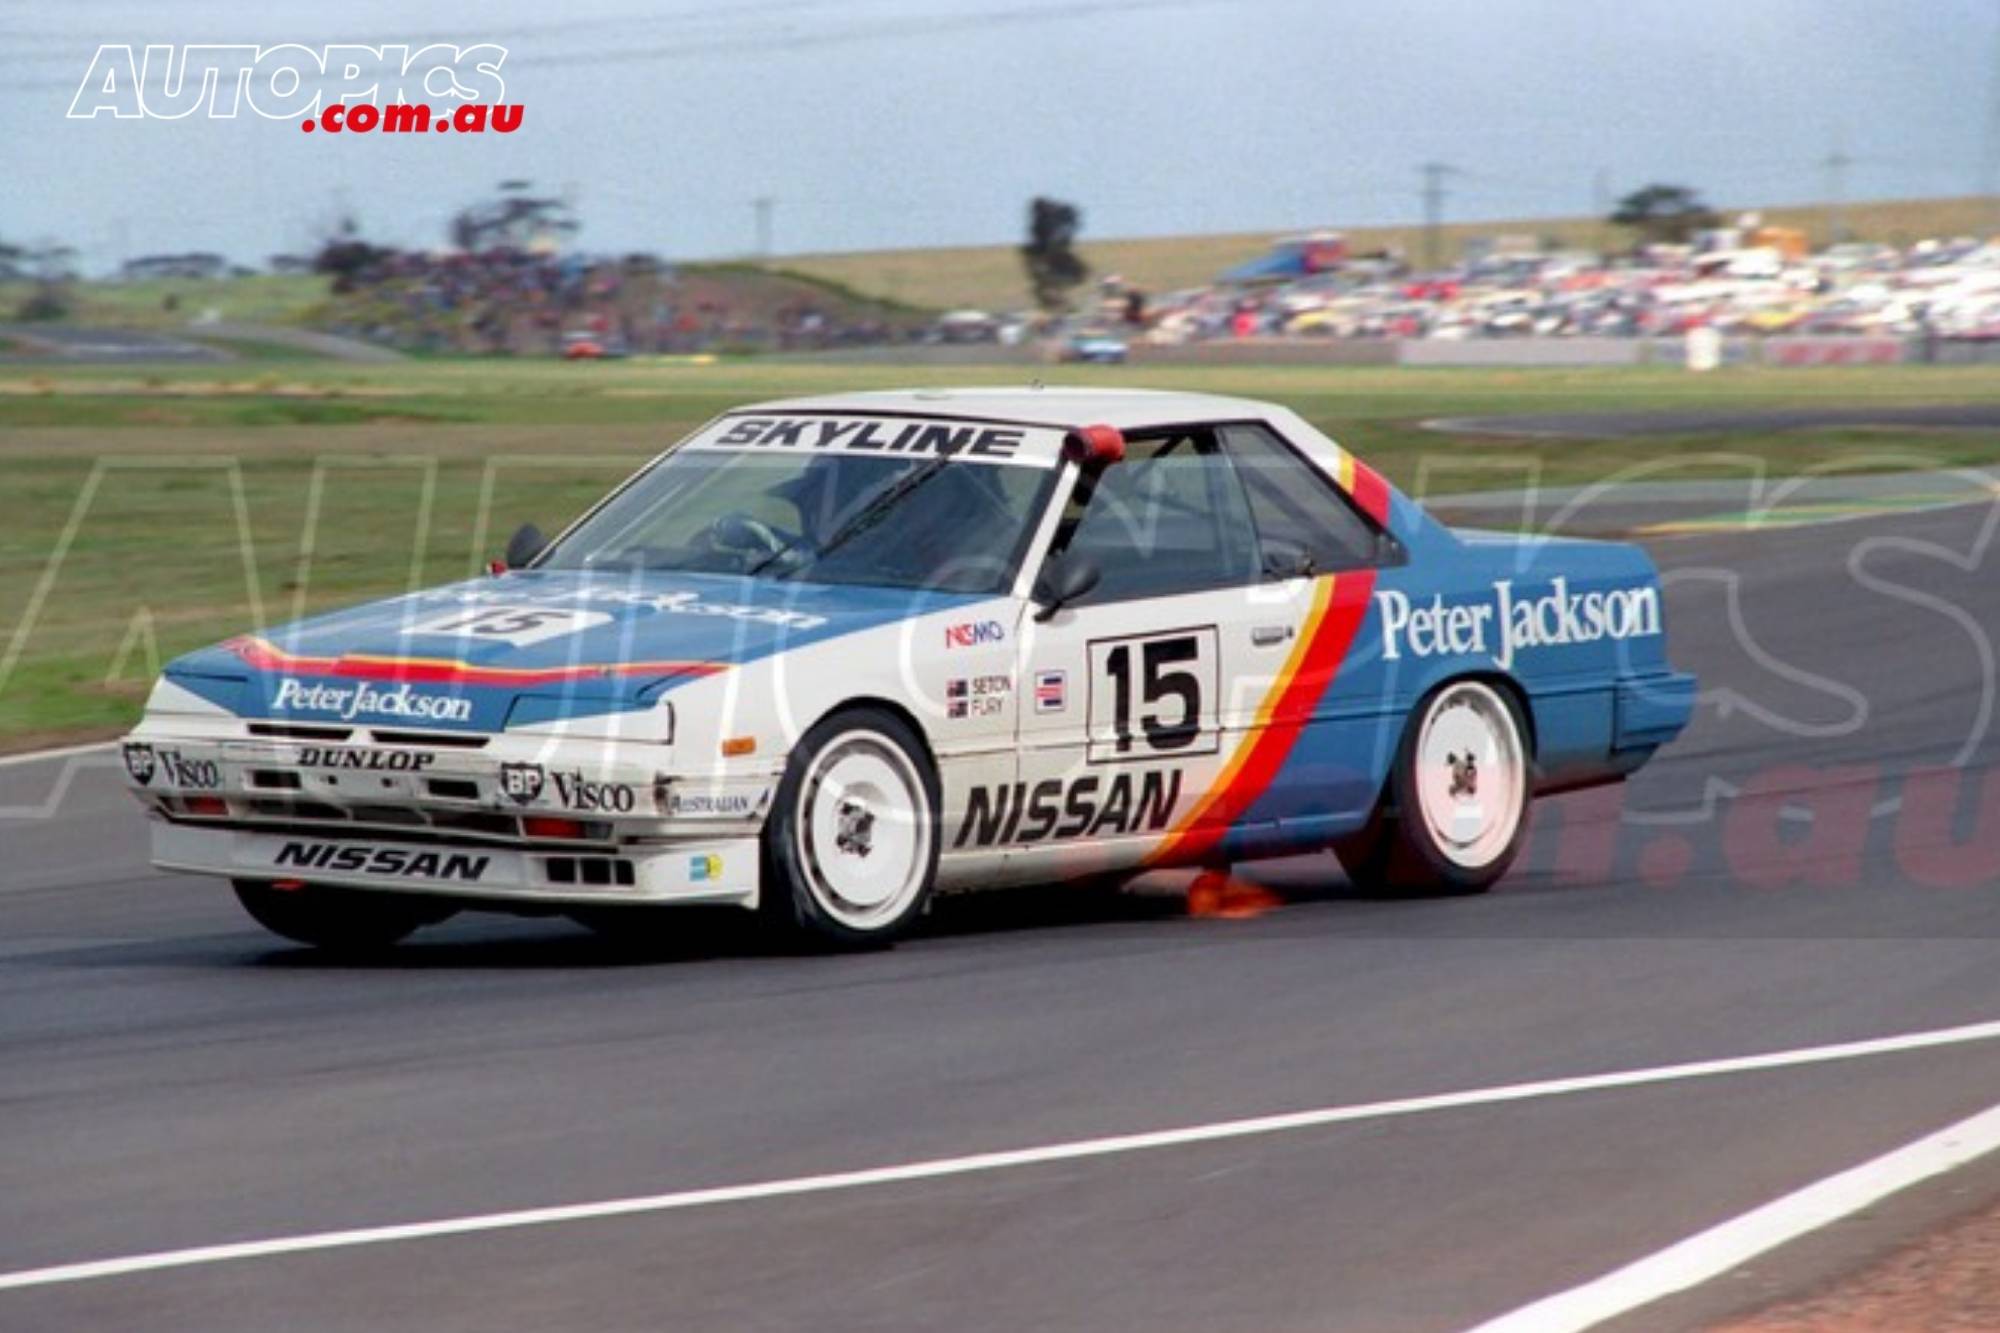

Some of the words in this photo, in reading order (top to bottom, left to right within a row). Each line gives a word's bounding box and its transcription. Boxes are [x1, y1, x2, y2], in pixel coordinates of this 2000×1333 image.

[716, 419, 1025, 458] SKYLINE
[1374, 588, 1492, 660] Peter
[1491, 575, 1662, 670] Jackson
[272, 677, 352, 711] Peter
[341, 680, 473, 722] Jackson
[1105, 635, 1200, 753] 15
[158, 748, 219, 789] Visco
[297, 747, 435, 771] DUNLOP
[551, 767, 635, 813] Visco
[953, 769, 1183, 849] NISSAN
[274, 841, 490, 880] NISSAN
